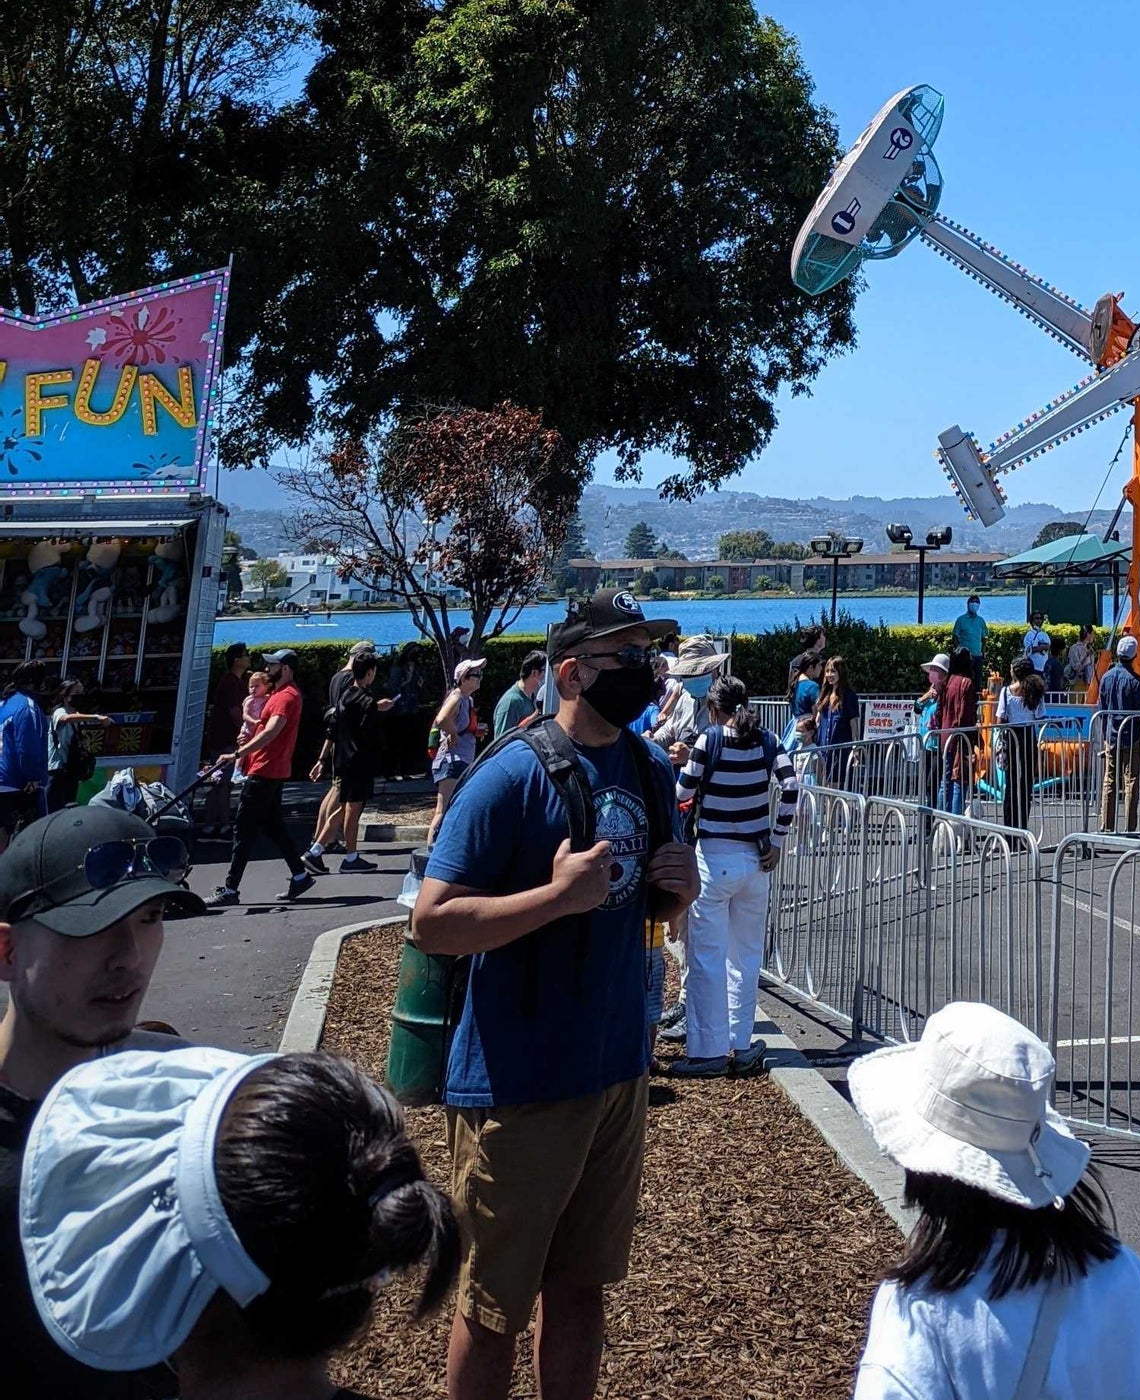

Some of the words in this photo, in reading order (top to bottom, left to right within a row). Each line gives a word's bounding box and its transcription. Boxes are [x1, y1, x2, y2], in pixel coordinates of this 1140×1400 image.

[893, 129, 911, 145] 2
[833, 214, 852, 230] 1
[25, 358, 197, 437] FUN
[868, 718, 893, 727] EATS
[609, 837, 644, 854] WAII
